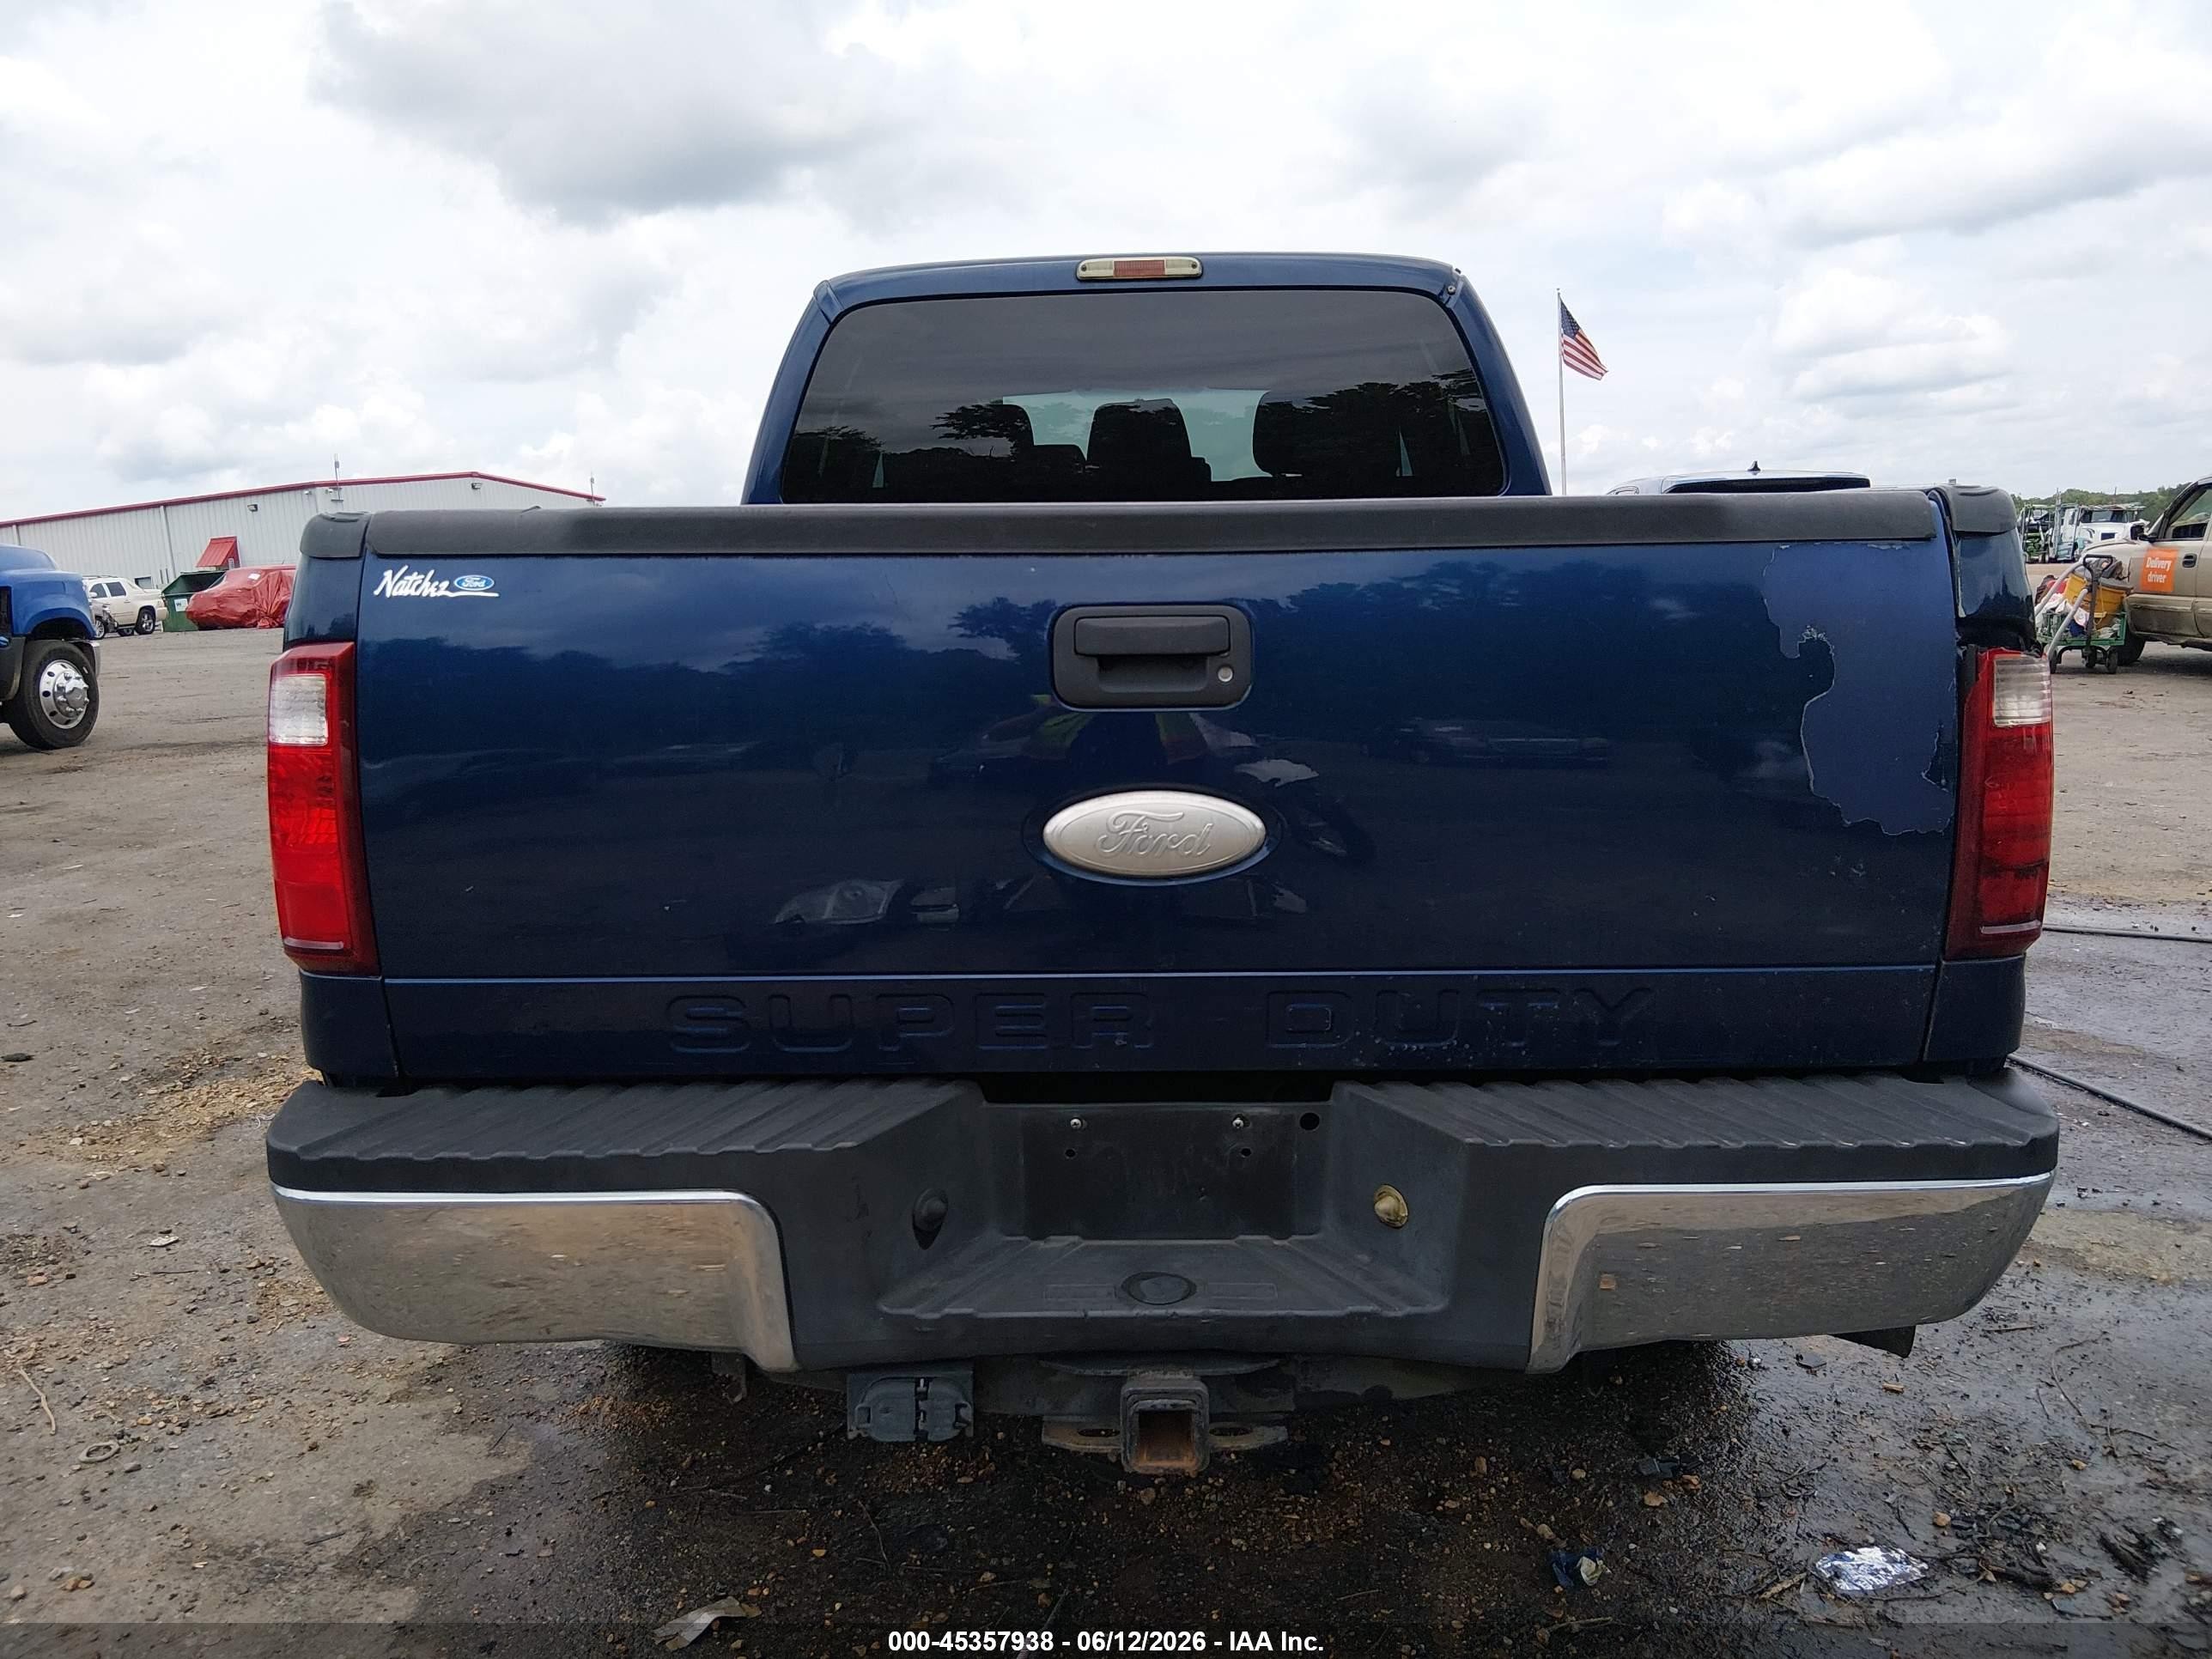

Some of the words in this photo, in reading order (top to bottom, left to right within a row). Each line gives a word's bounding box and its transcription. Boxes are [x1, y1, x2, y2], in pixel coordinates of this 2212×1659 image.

[2146, 556, 2172, 571] Delivery
[2148, 571, 2167, 583] driver
[374, 564, 455, 598] Natchez
[460, 576, 489, 589] Ford
[1096, 810, 1213, 856] Ford
[666, 992, 1152, 1053] SUPER
[1266, 988, 1653, 1048] DUTY
